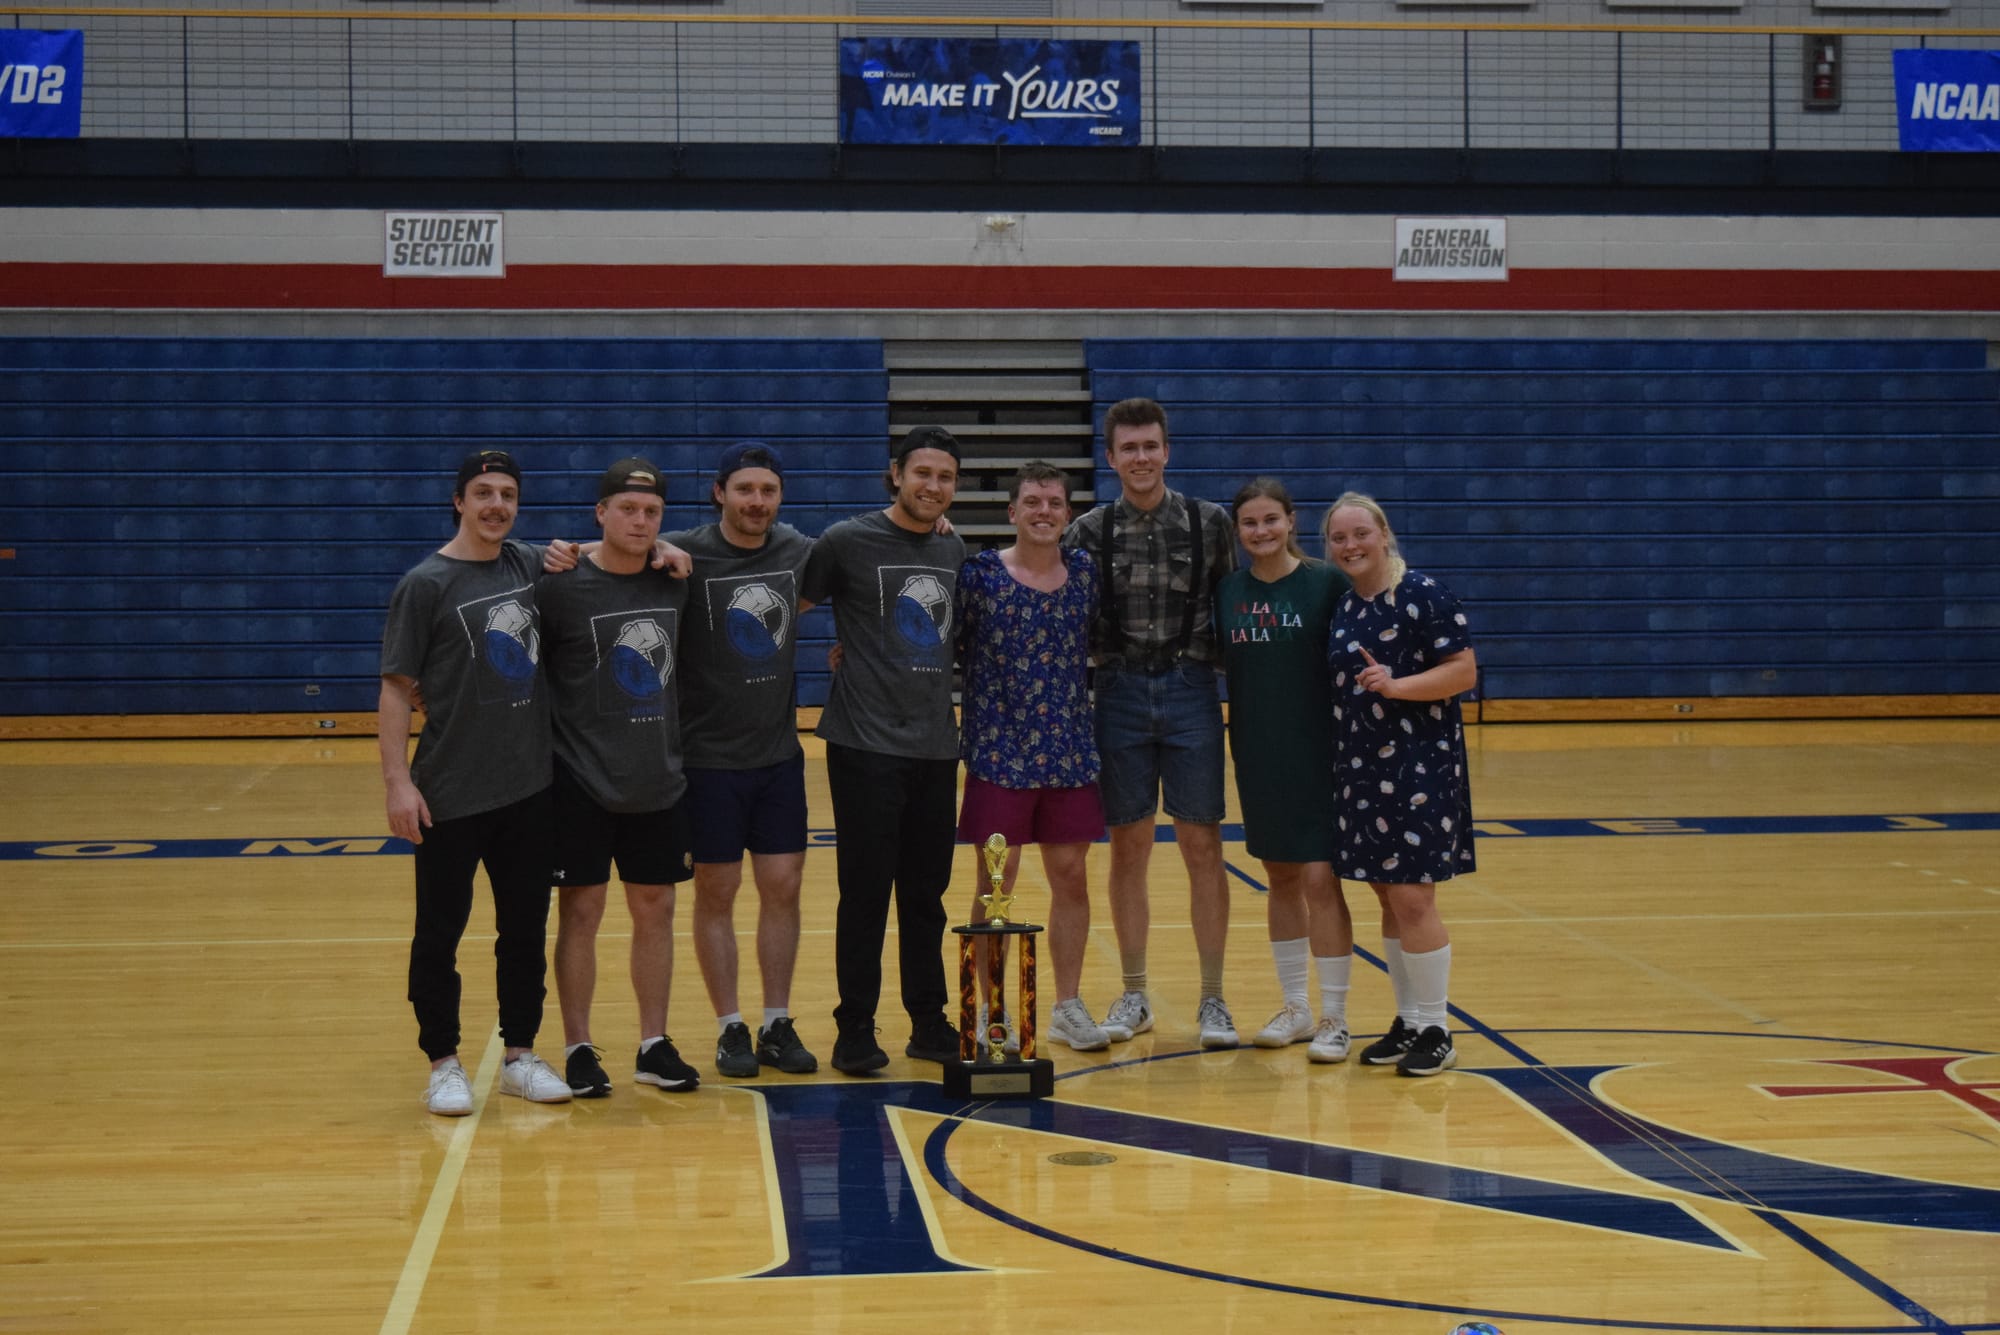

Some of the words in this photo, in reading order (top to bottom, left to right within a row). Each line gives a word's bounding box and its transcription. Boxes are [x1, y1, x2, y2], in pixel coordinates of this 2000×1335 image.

[882, 84, 966, 106] MAKE
[972, 84, 1001, 107] IT
[1002, 65, 1120, 120] YOURS
[1911, 82, 2000, 120] NCAA
[390, 219, 498, 242] STUDENT
[1411, 229, 1490, 248] GENERAL
[393, 242, 494, 266] SECTION
[1397, 248, 1505, 267] ADMISSION
[1252, 601, 1270, 614] LA
[1282, 613, 1303, 627] LA
[1231, 628, 1248, 643] LA
[1251, 627, 1270, 642] LA
